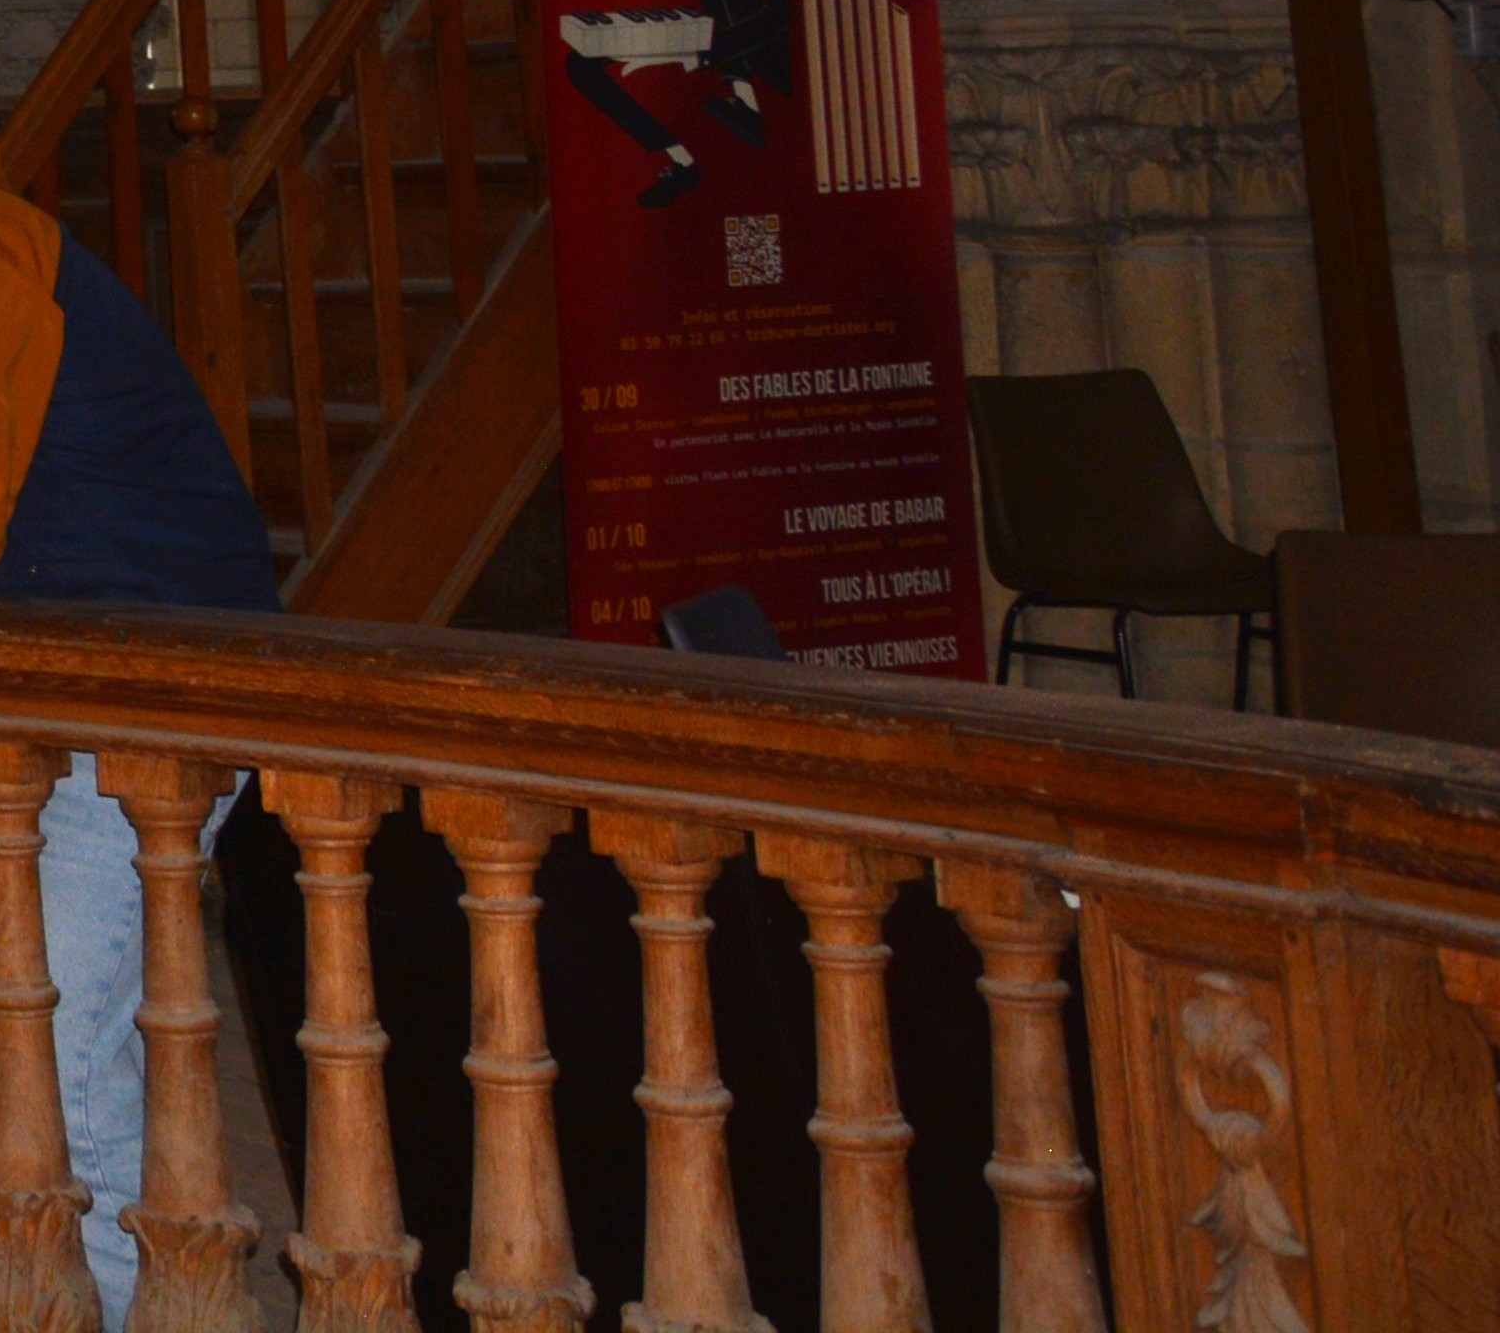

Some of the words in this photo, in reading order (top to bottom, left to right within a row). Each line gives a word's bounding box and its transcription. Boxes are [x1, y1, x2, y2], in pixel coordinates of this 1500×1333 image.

[581, 387, 599, 412] 30
[615, 384, 638, 408] 09
[719, 375, 751, 402] DES
[753, 371, 812, 400] FABLES
[814, 369, 835, 395] DE
[838, 367, 860, 393] LA
[862, 361, 934, 391] FONTAINE
[784, 507, 805, 535] LE
[807, 502, 868, 532] VOYAGE
[871, 500, 892, 527] DE
[894, 495, 945, 524] BABAR
[586, 526, 607, 551] 01
[625, 522, 647, 548] 10
[820, 576, 863, 604] TOUS
[864, 568, 877, 599] À
[879, 567, 941, 598] L'OPÉRA
[591, 599, 612, 625] 04
[631, 595, 651, 621] 10
[866, 635, 958, 668] VIENNOISES
